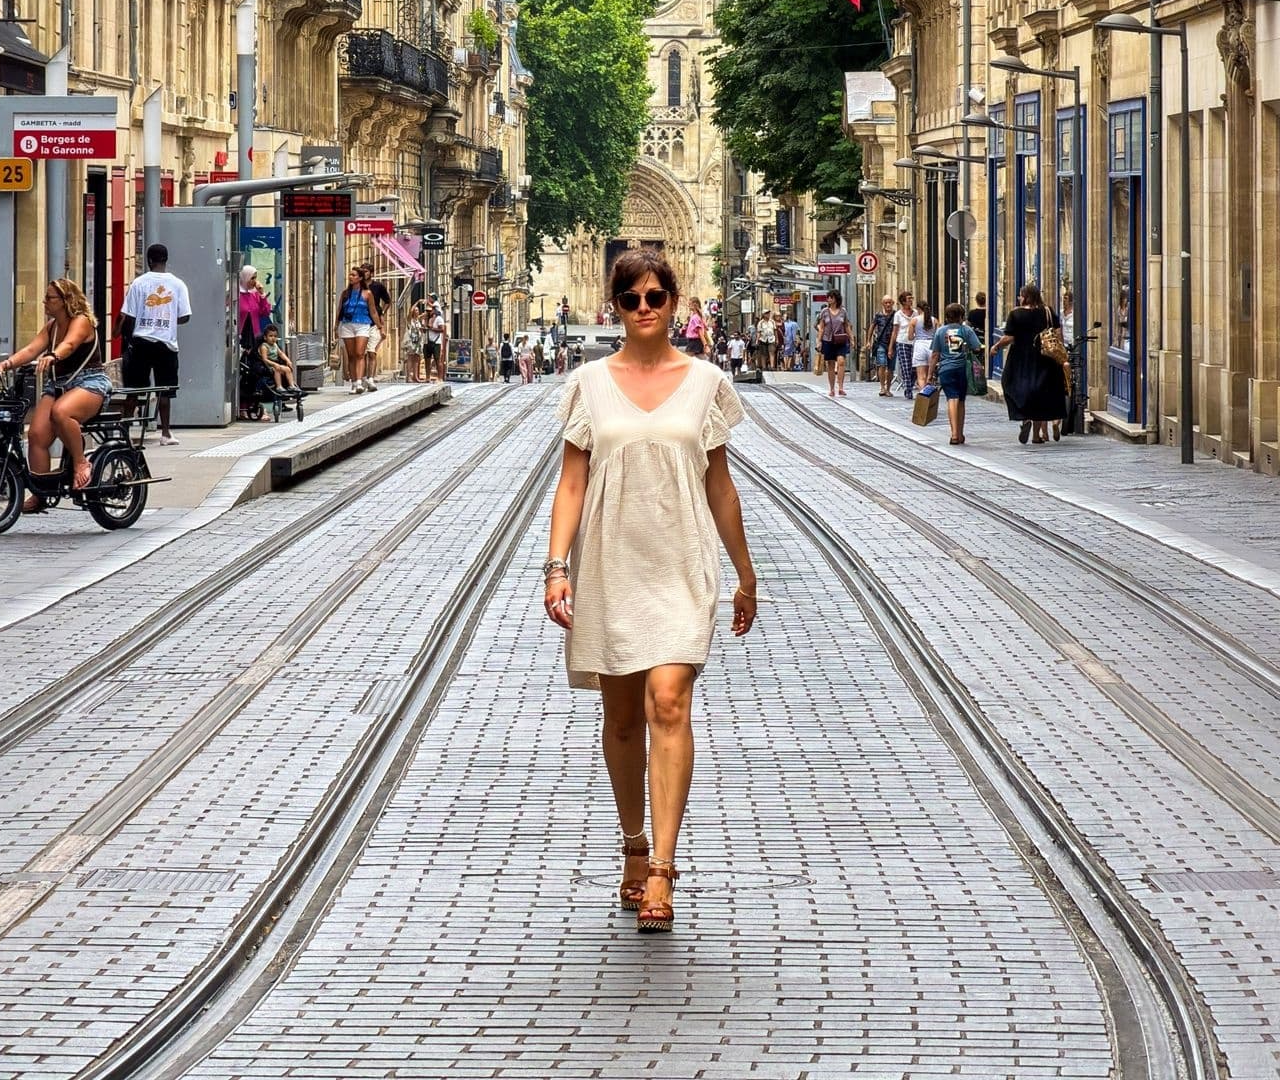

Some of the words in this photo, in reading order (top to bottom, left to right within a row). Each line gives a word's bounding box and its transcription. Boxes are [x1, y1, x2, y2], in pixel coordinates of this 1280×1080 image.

[25, 139, 33, 150] B
[41, 135, 75, 144] Berges
[78, 135, 90, 144] de
[41, 146, 49, 154] la
[52, 146, 94, 154] Garonne
[3, 166, 23, 183] 25
